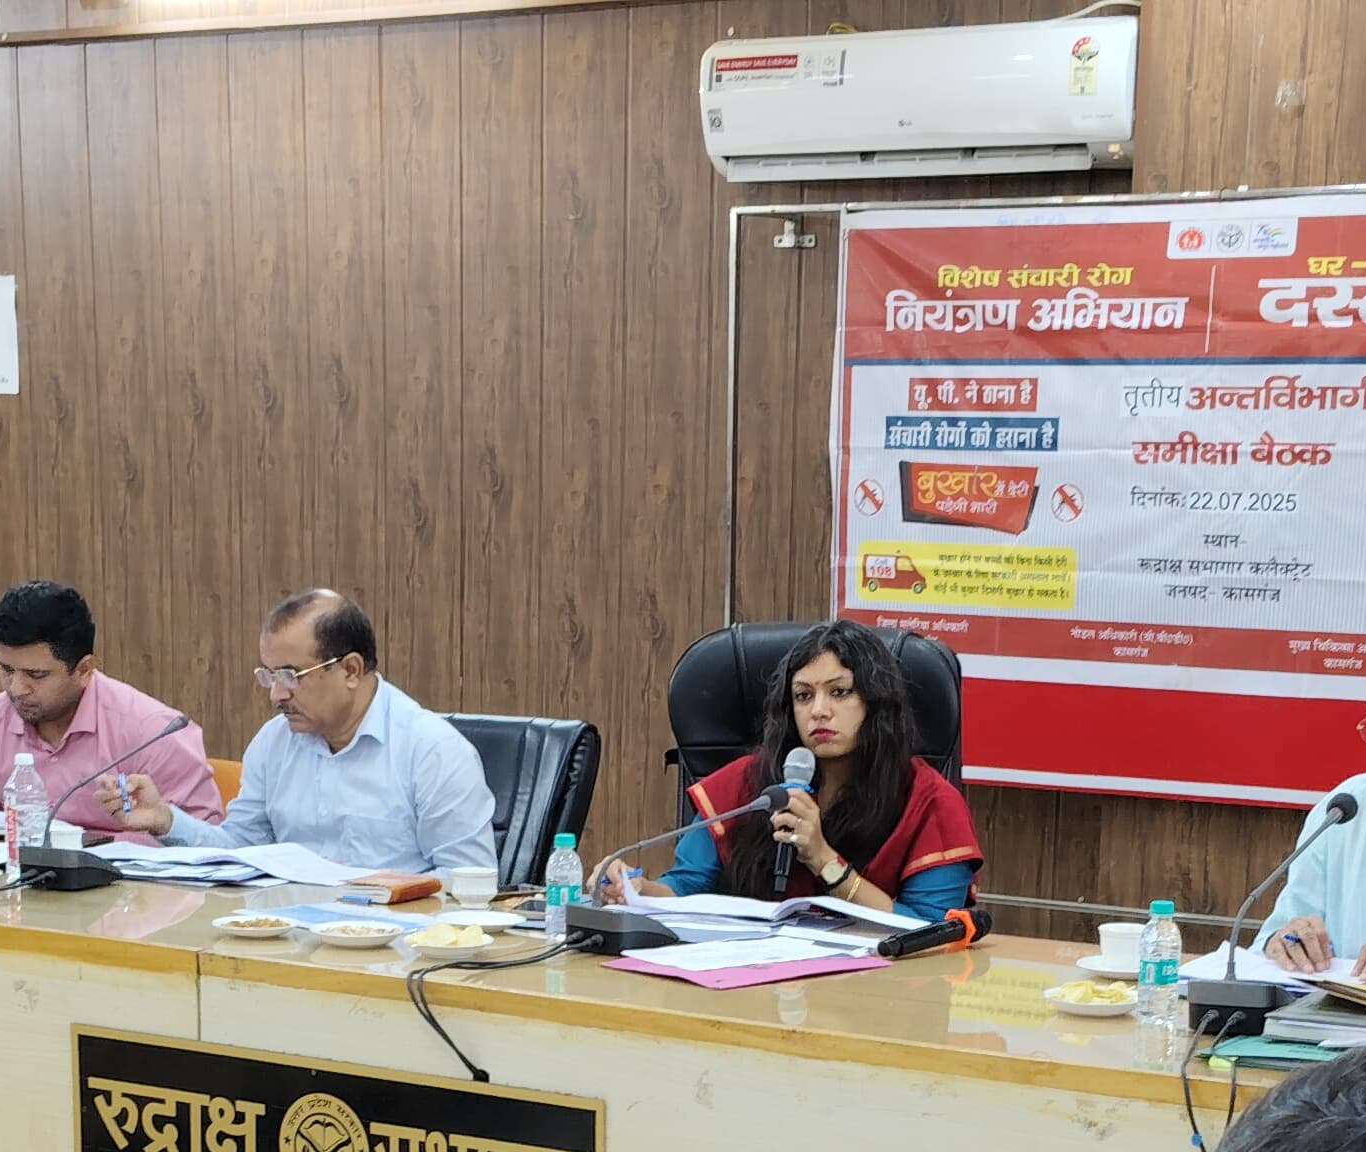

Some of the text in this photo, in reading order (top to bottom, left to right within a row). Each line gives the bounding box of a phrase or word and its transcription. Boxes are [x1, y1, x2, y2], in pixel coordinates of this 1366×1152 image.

[938, 262, 1134, 288] विशेष संचारी रोग
[1307, 256, 1347, 275] घर
[885, 286, 1190, 332] नियंत्रण अभियान
[965, 379, 979, 404] ने
[1020, 379, 1033, 405] है
[1123, 377, 1183, 416] तृतीय
[889, 420, 1054, 449] संचारी रोगों को हराना है
[1132, 431, 1336, 466] समीक्षा बैठक
[918, 466, 998, 504] बुखार
[1189, 492, 1298, 512] 22.07.2025
[1187, 557, 1244, 574] सभागार
[1222, 583, 1281, 601] कासगंज
